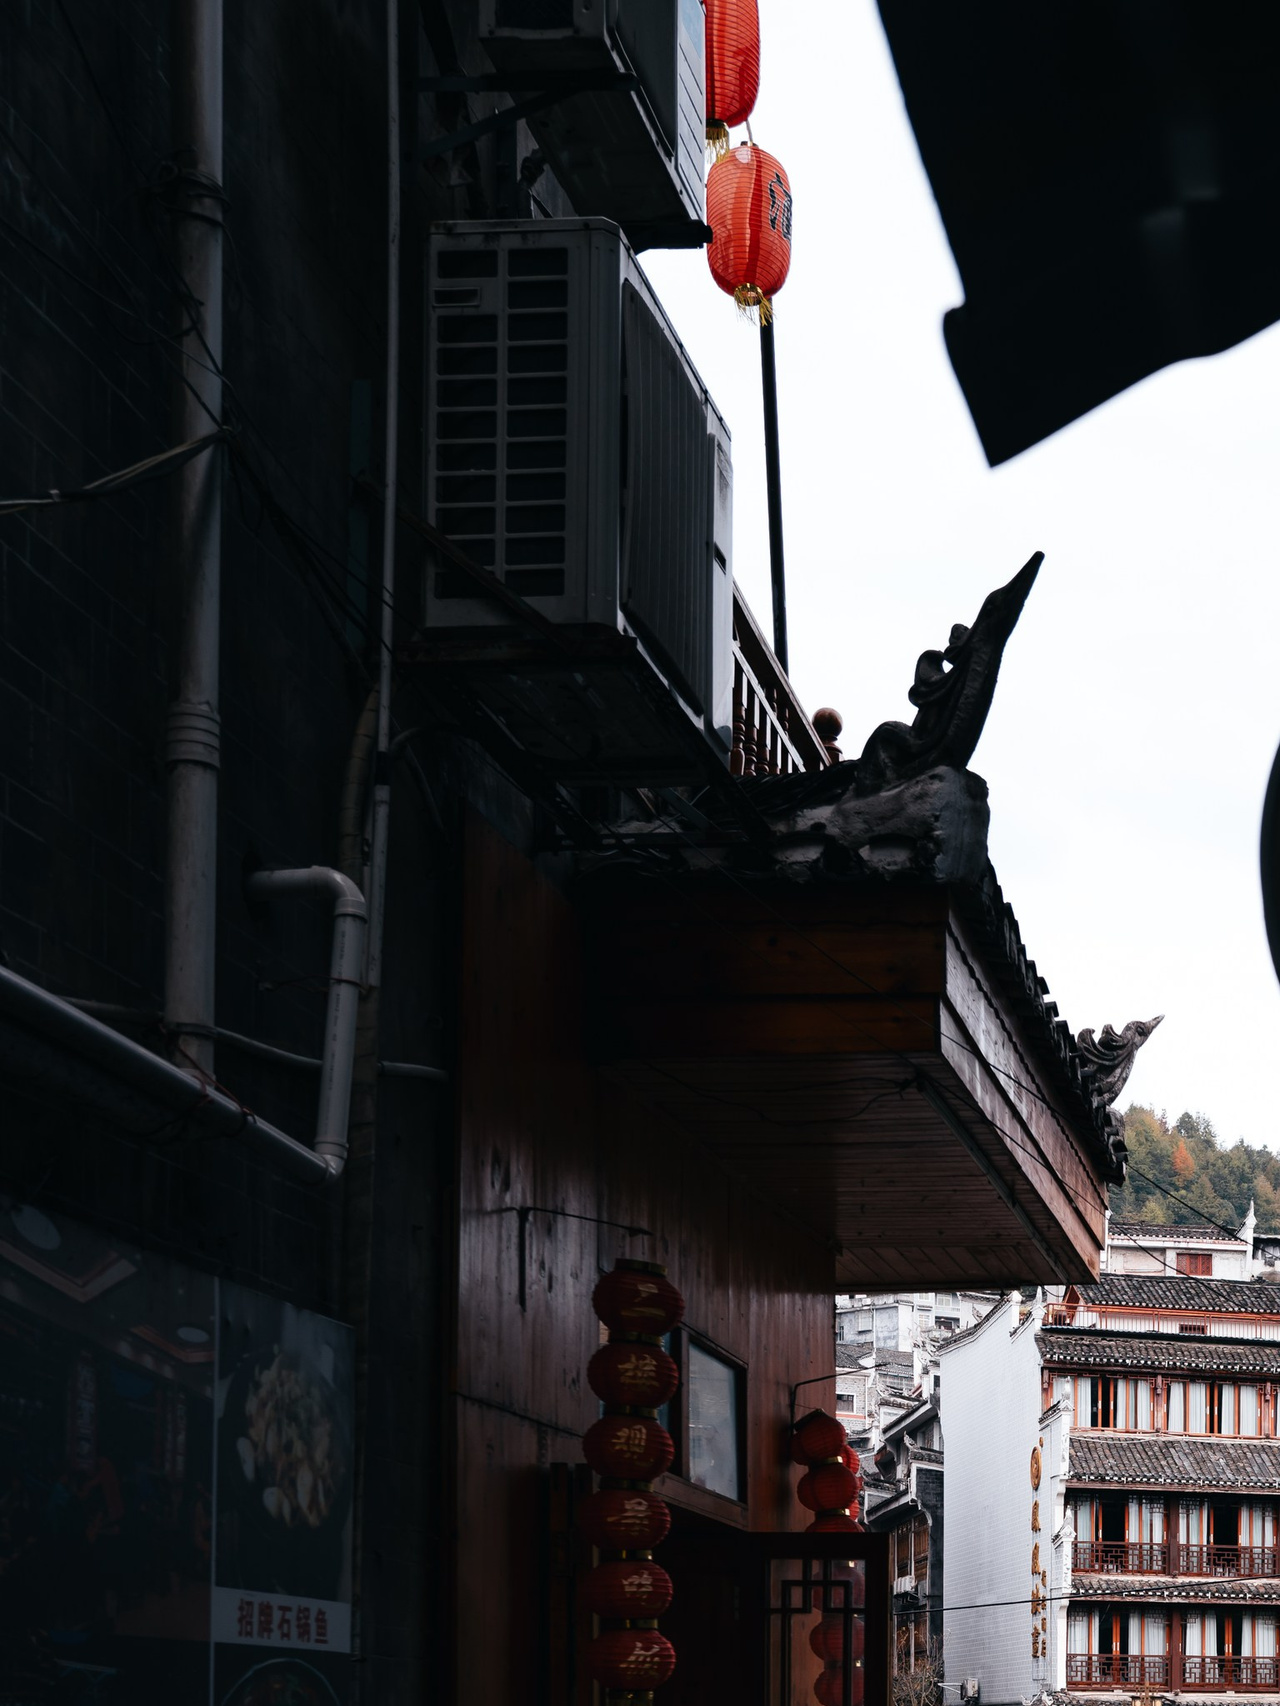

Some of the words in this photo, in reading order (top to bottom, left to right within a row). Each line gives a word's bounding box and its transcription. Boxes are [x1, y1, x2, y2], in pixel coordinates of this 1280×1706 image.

[237, 1599, 329, 1645] 招牌石锅鱼
